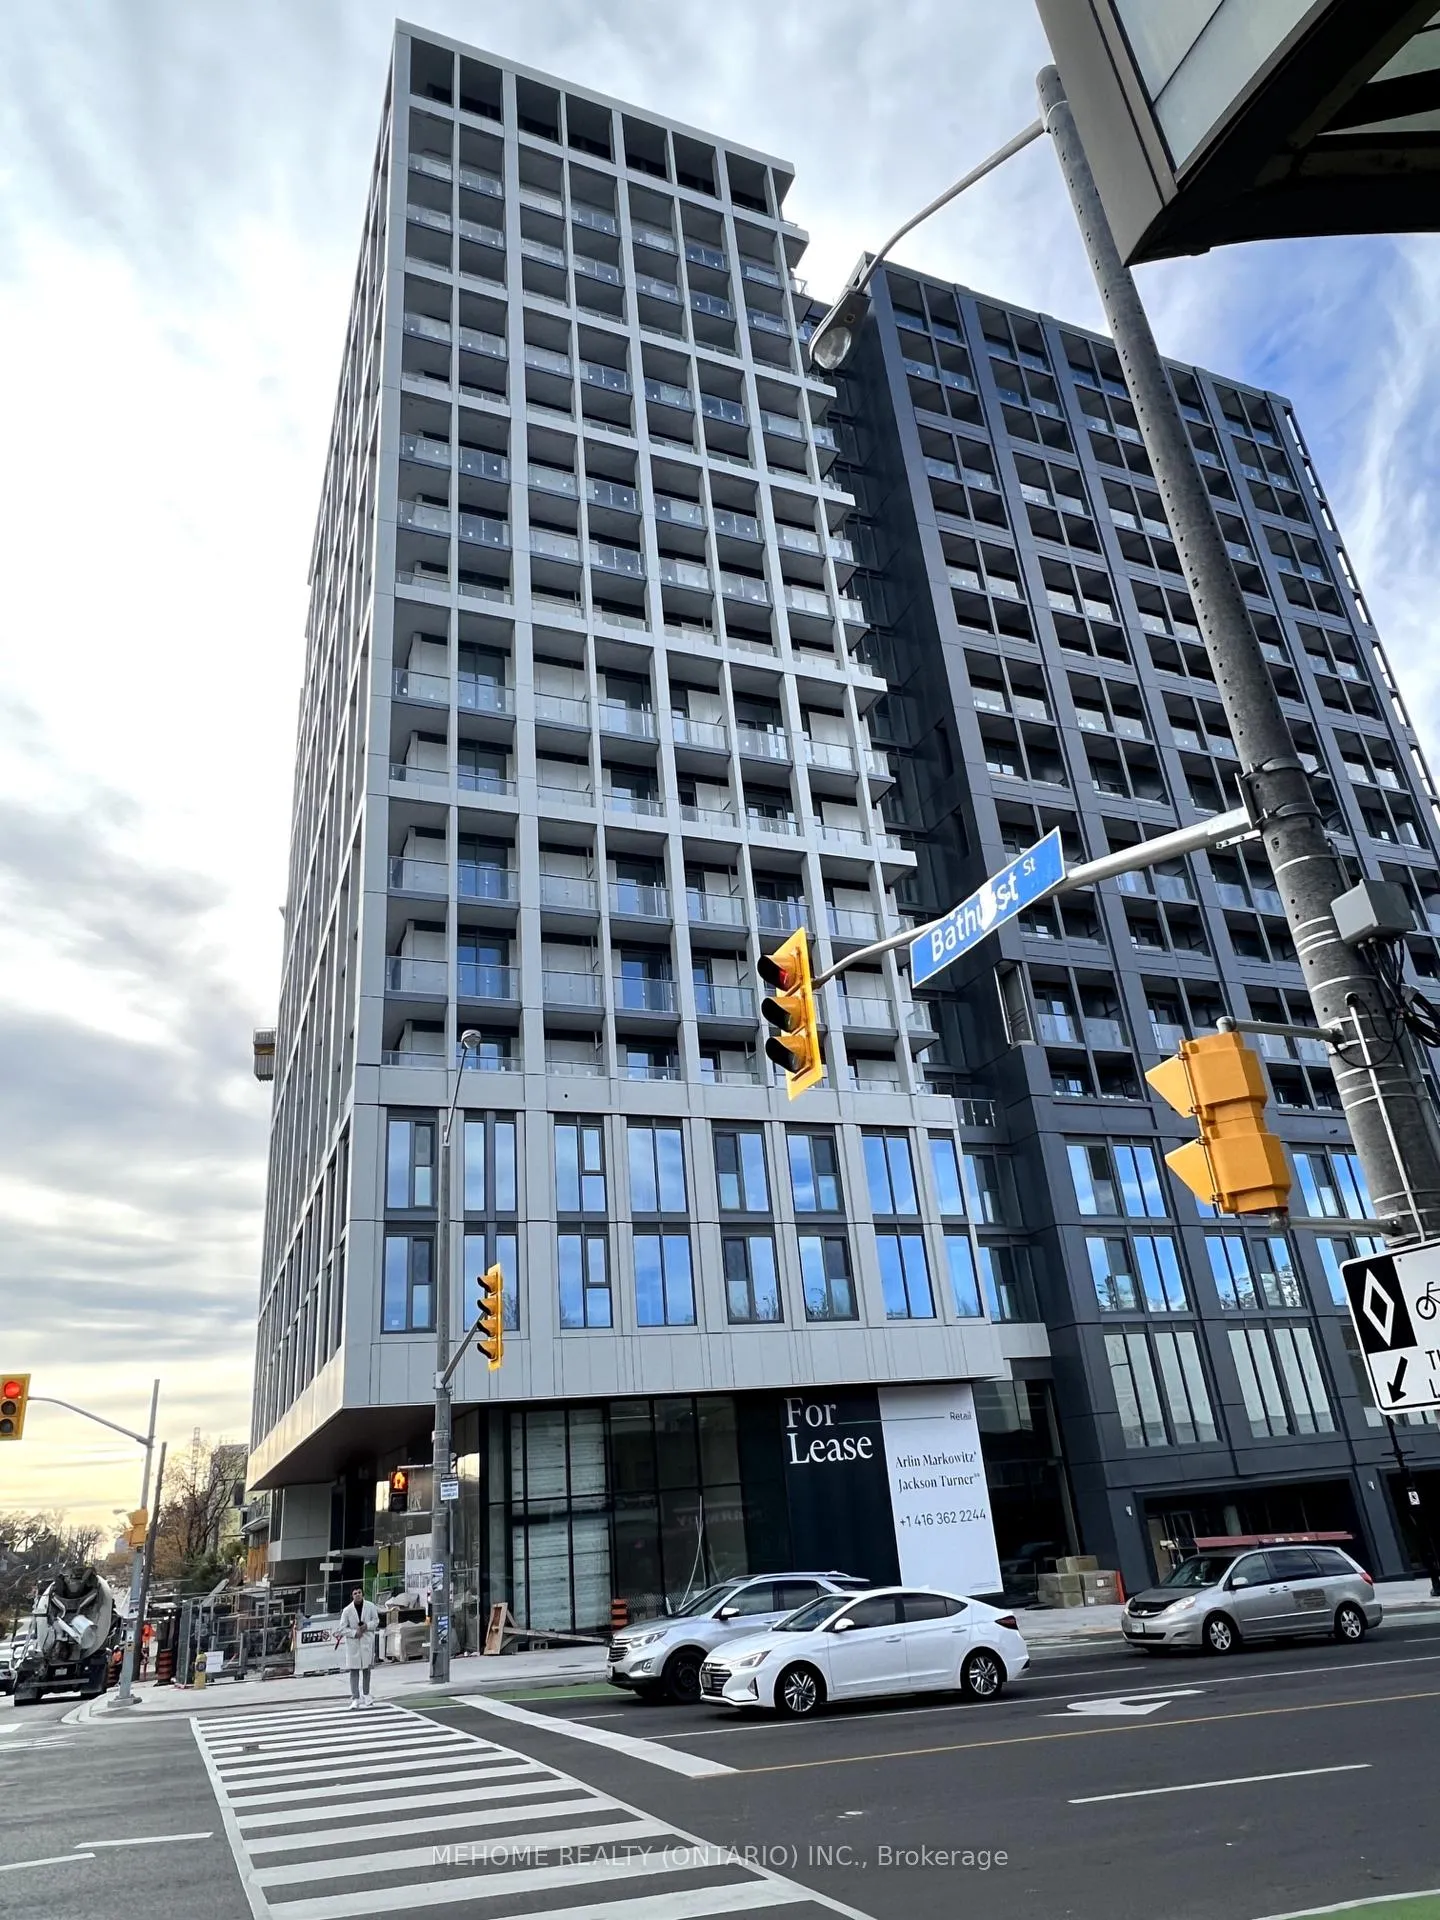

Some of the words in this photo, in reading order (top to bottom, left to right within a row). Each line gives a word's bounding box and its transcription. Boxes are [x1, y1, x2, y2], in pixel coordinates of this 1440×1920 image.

[931, 872, 1018, 962] Bathst
[1022, 857, 1036, 876] St
[784, 1397, 837, 1429] For
[949, 1411, 972, 1421] Retail
[786, 1432, 874, 1465] Lease
[896, 1454, 921, 1468] Arlin
[898, 1476, 938, 1494] Jackson
[899, 1515, 911, 1527] +1
[914, 1513, 934, 1526] 416
[936, 1510, 957, 1525] 362
[959, 1508, 986, 1523] 2244
